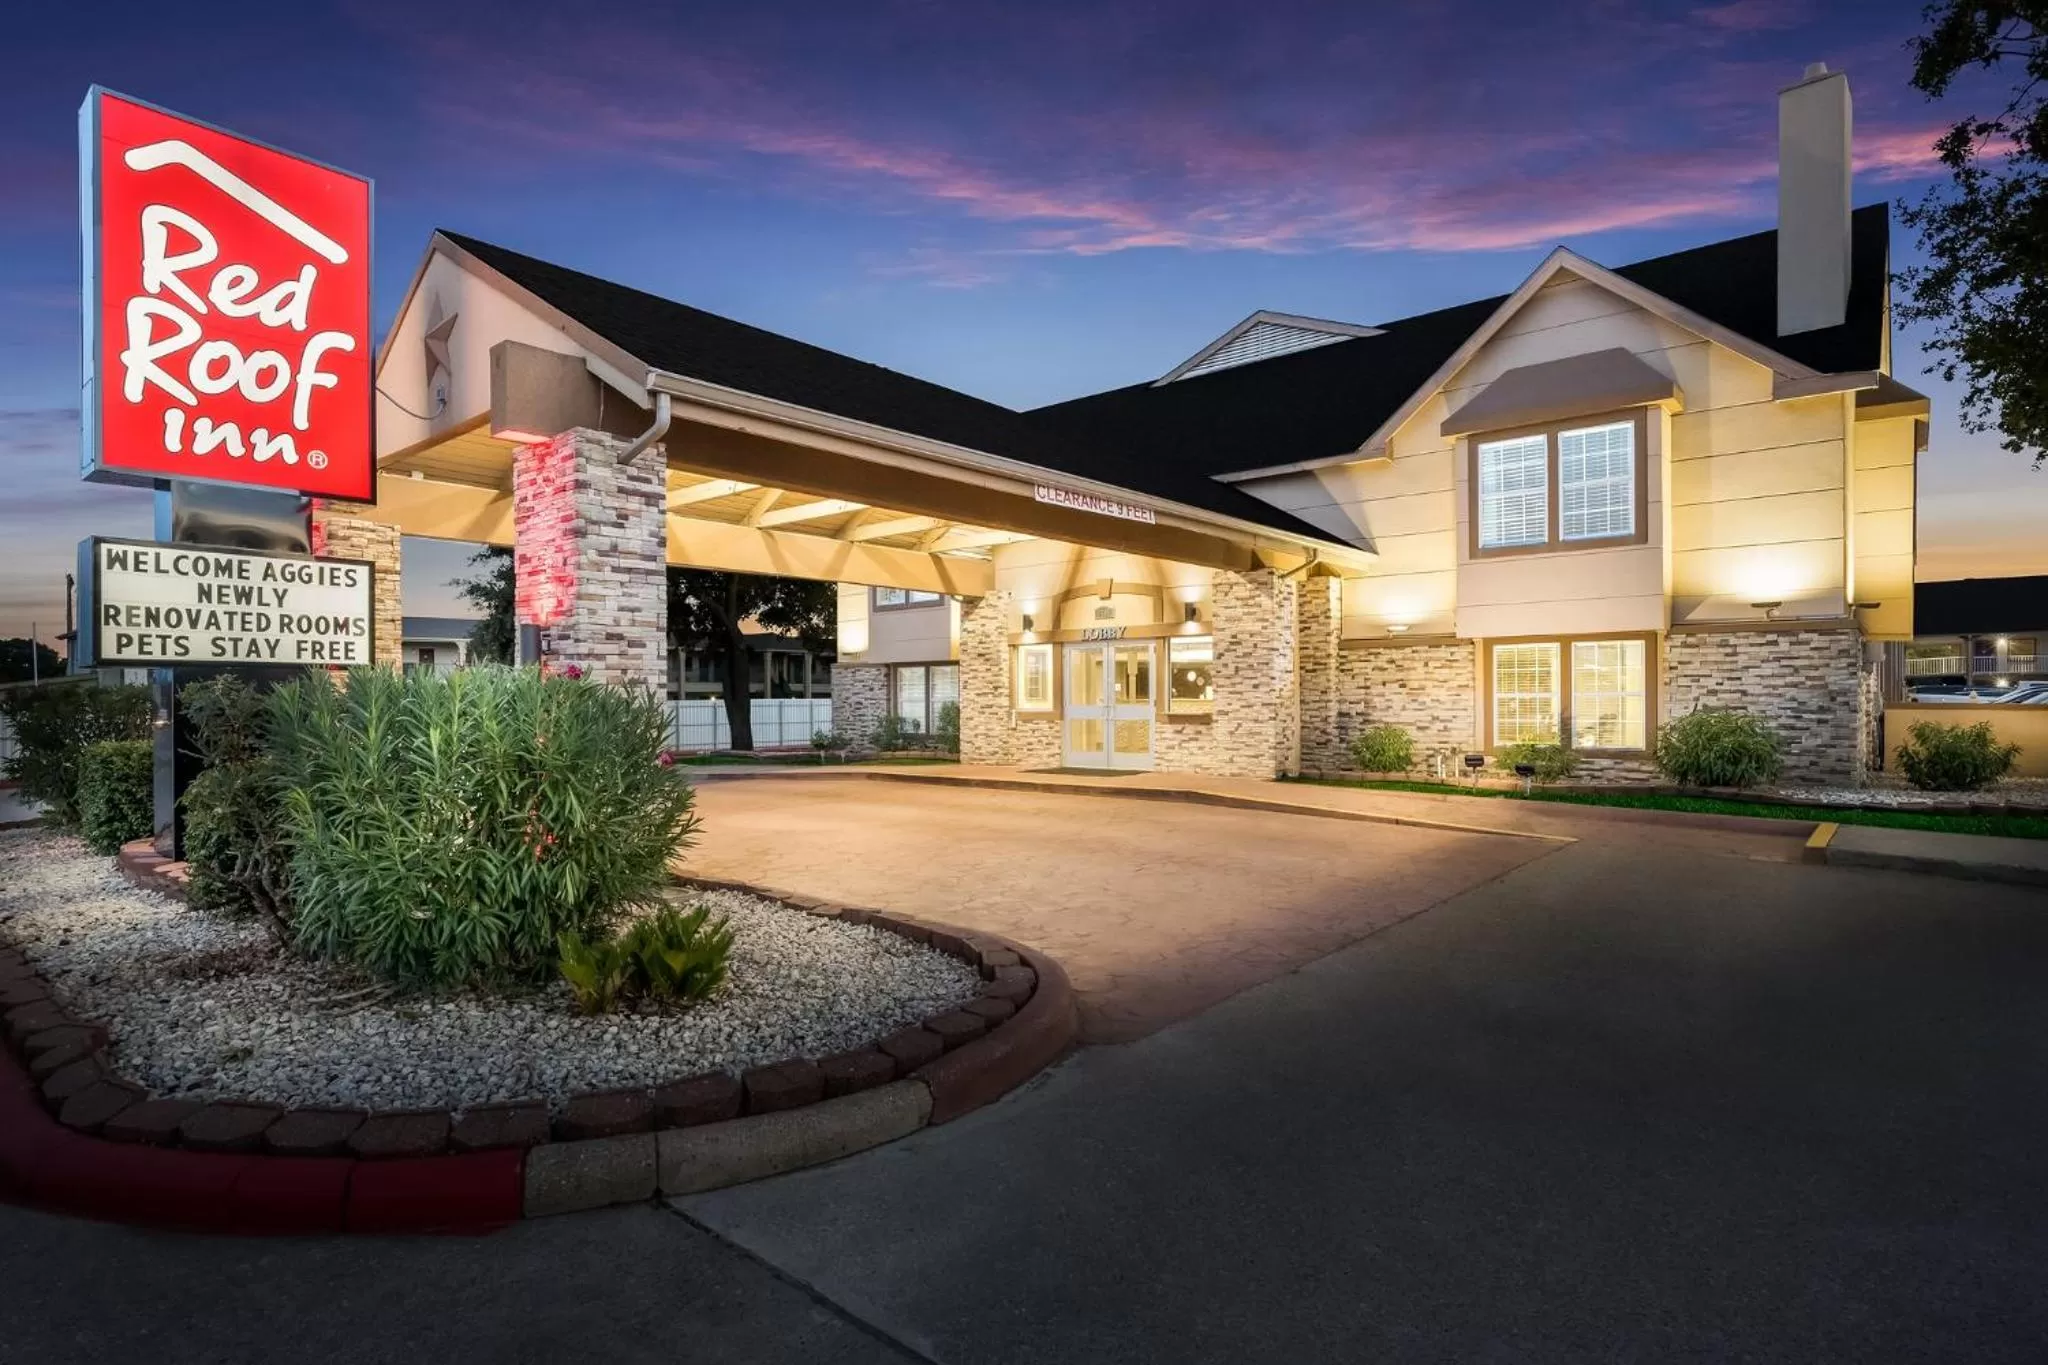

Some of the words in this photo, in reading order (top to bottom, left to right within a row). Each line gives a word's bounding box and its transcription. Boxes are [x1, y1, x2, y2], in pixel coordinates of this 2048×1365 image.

[141, 204, 318, 331] Red
[120, 296, 356, 431] Roof
[1036, 484, 1115, 514] CLEARANCE
[1117, 504, 1124, 517] 9
[1126, 507, 1154, 522] FEET
[106, 548, 251, 580] WELCOME
[262, 562, 357, 588] AGGIES
[197, 582, 289, 608] NEWLY
[103, 604, 271, 633] RENOVATED
[279, 613, 366, 638] ROOMS
[1081, 626, 1127, 642] LOBBY
[116, 632, 190, 658] PETS
[211, 636, 281, 659] STAY
[296, 639, 356, 661] FREE
